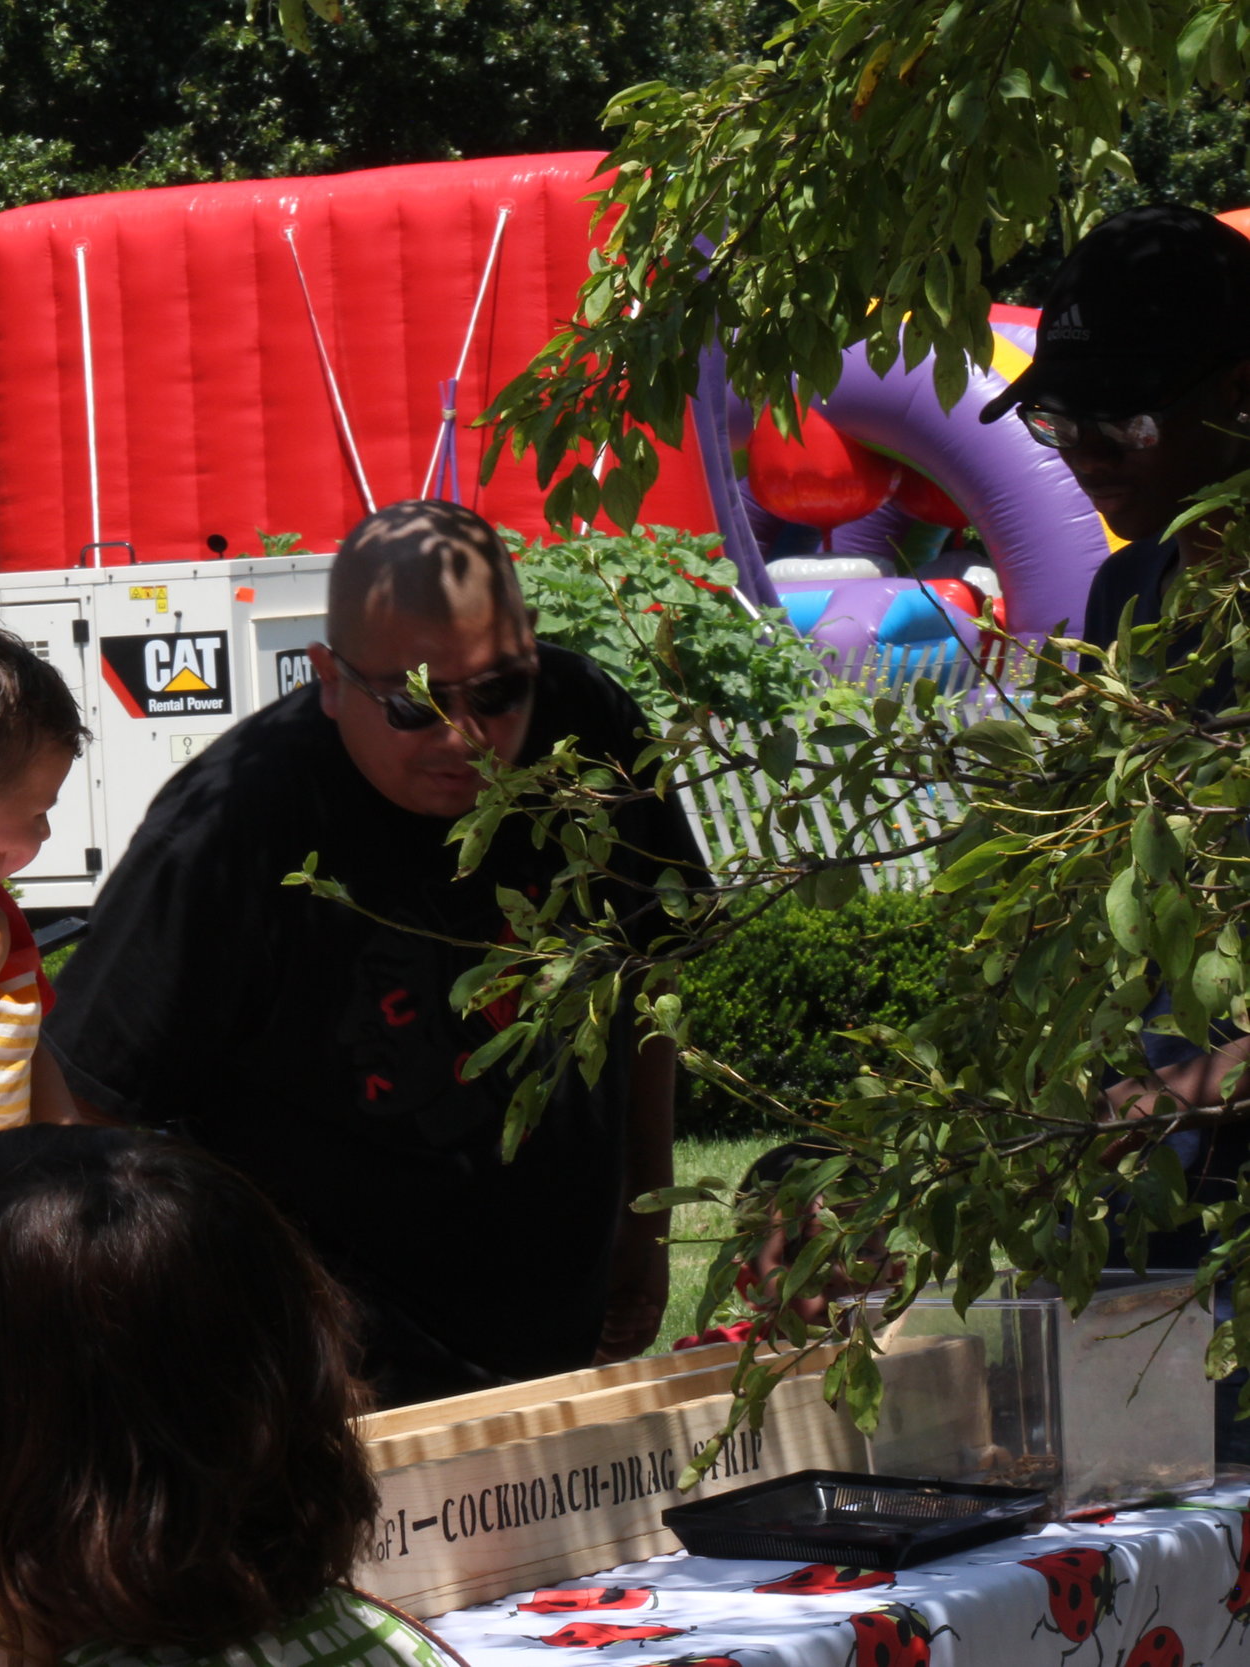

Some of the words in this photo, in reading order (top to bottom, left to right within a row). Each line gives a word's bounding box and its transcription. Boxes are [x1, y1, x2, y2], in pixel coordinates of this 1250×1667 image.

[1046, 326, 1092, 341] adidas
[144, 637, 221, 693] CAT
[280, 655, 314, 696] CAT
[148, 697, 184, 713] Rental
[187, 696, 224, 711] Power
